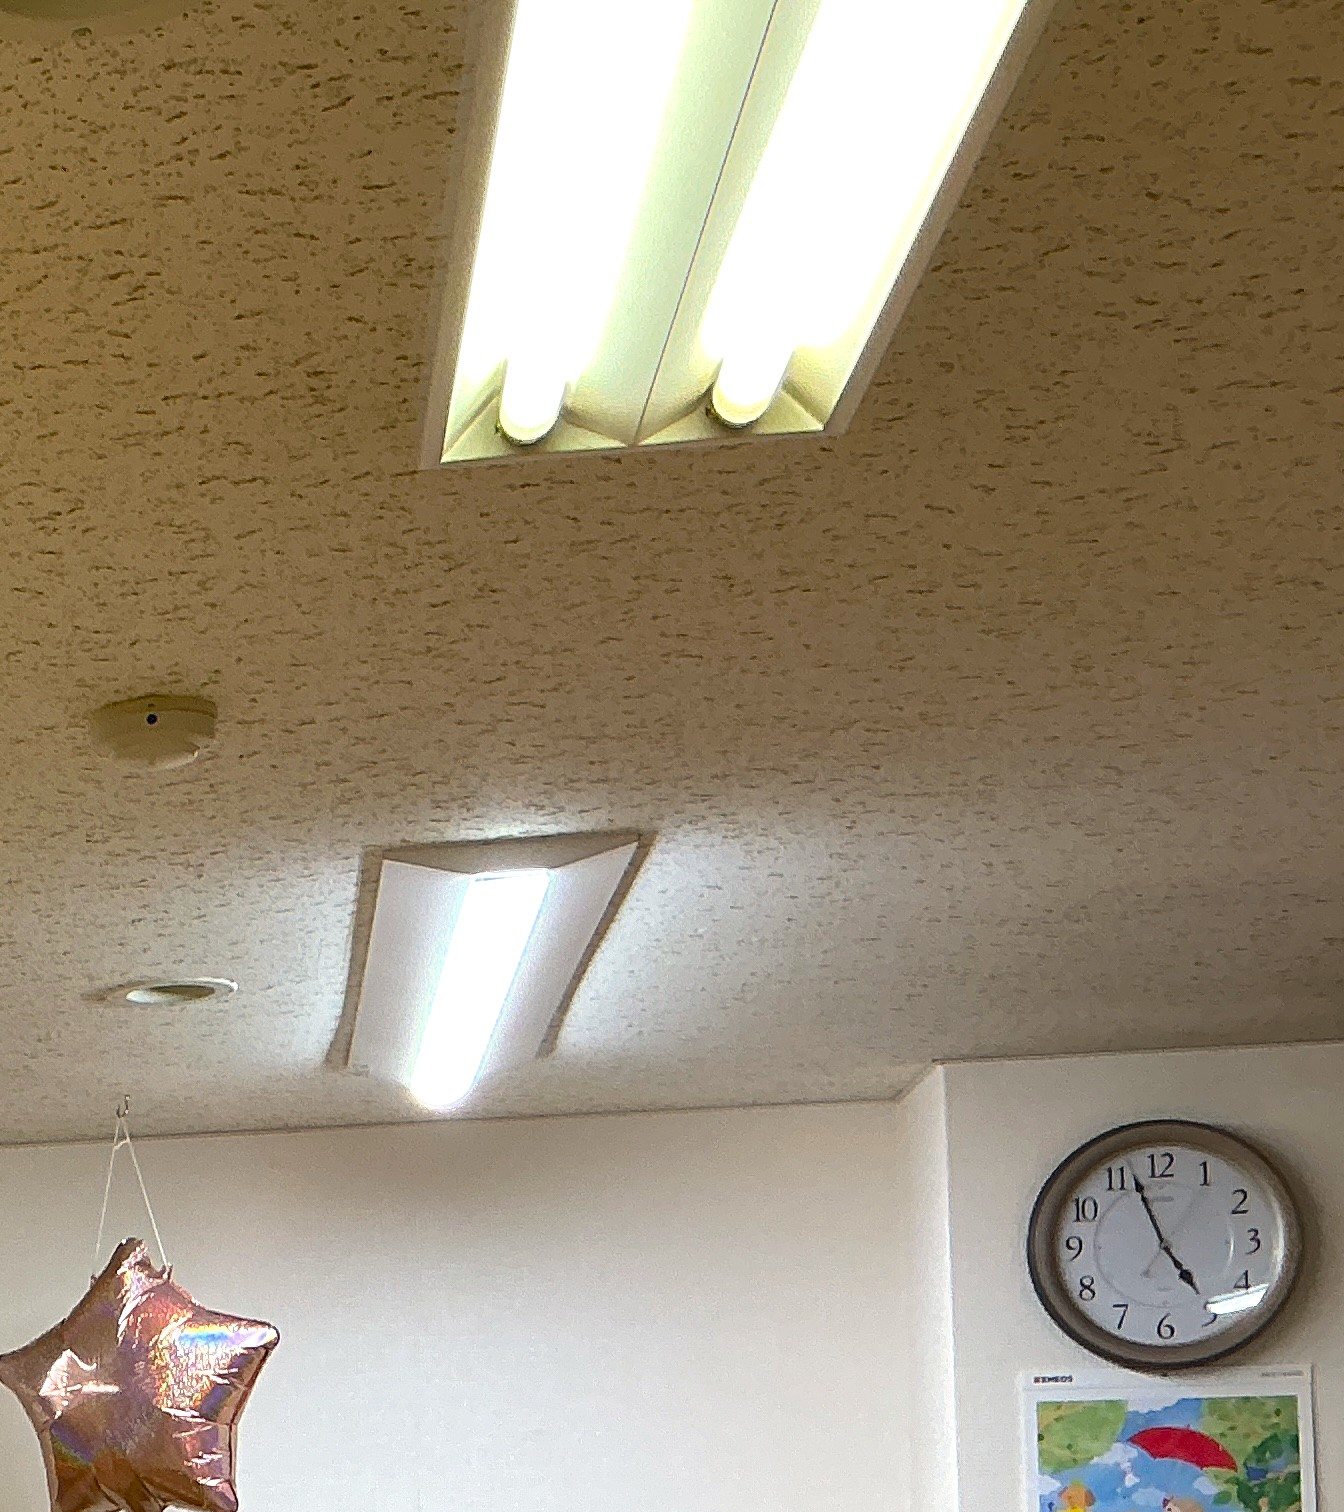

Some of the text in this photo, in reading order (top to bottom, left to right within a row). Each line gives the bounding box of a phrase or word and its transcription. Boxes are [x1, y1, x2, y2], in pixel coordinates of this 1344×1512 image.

[1106, 1166, 1126, 1191] 11
[1147, 1152, 1175, 1179] 12
[1199, 1161, 1211, 1187] 1
[1073, 1196, 1099, 1223] 10
[1231, 1188, 1249, 1215] 2
[1065, 1235, 1083, 1262] 9
[1246, 1228, 1261, 1255] 3
[1078, 1275, 1096, 1301] 8
[1233, 1269, 1251, 1290] 4
[1113, 1303, 1129, 1330] 7
[1157, 1312, 1175, 1340] 6
